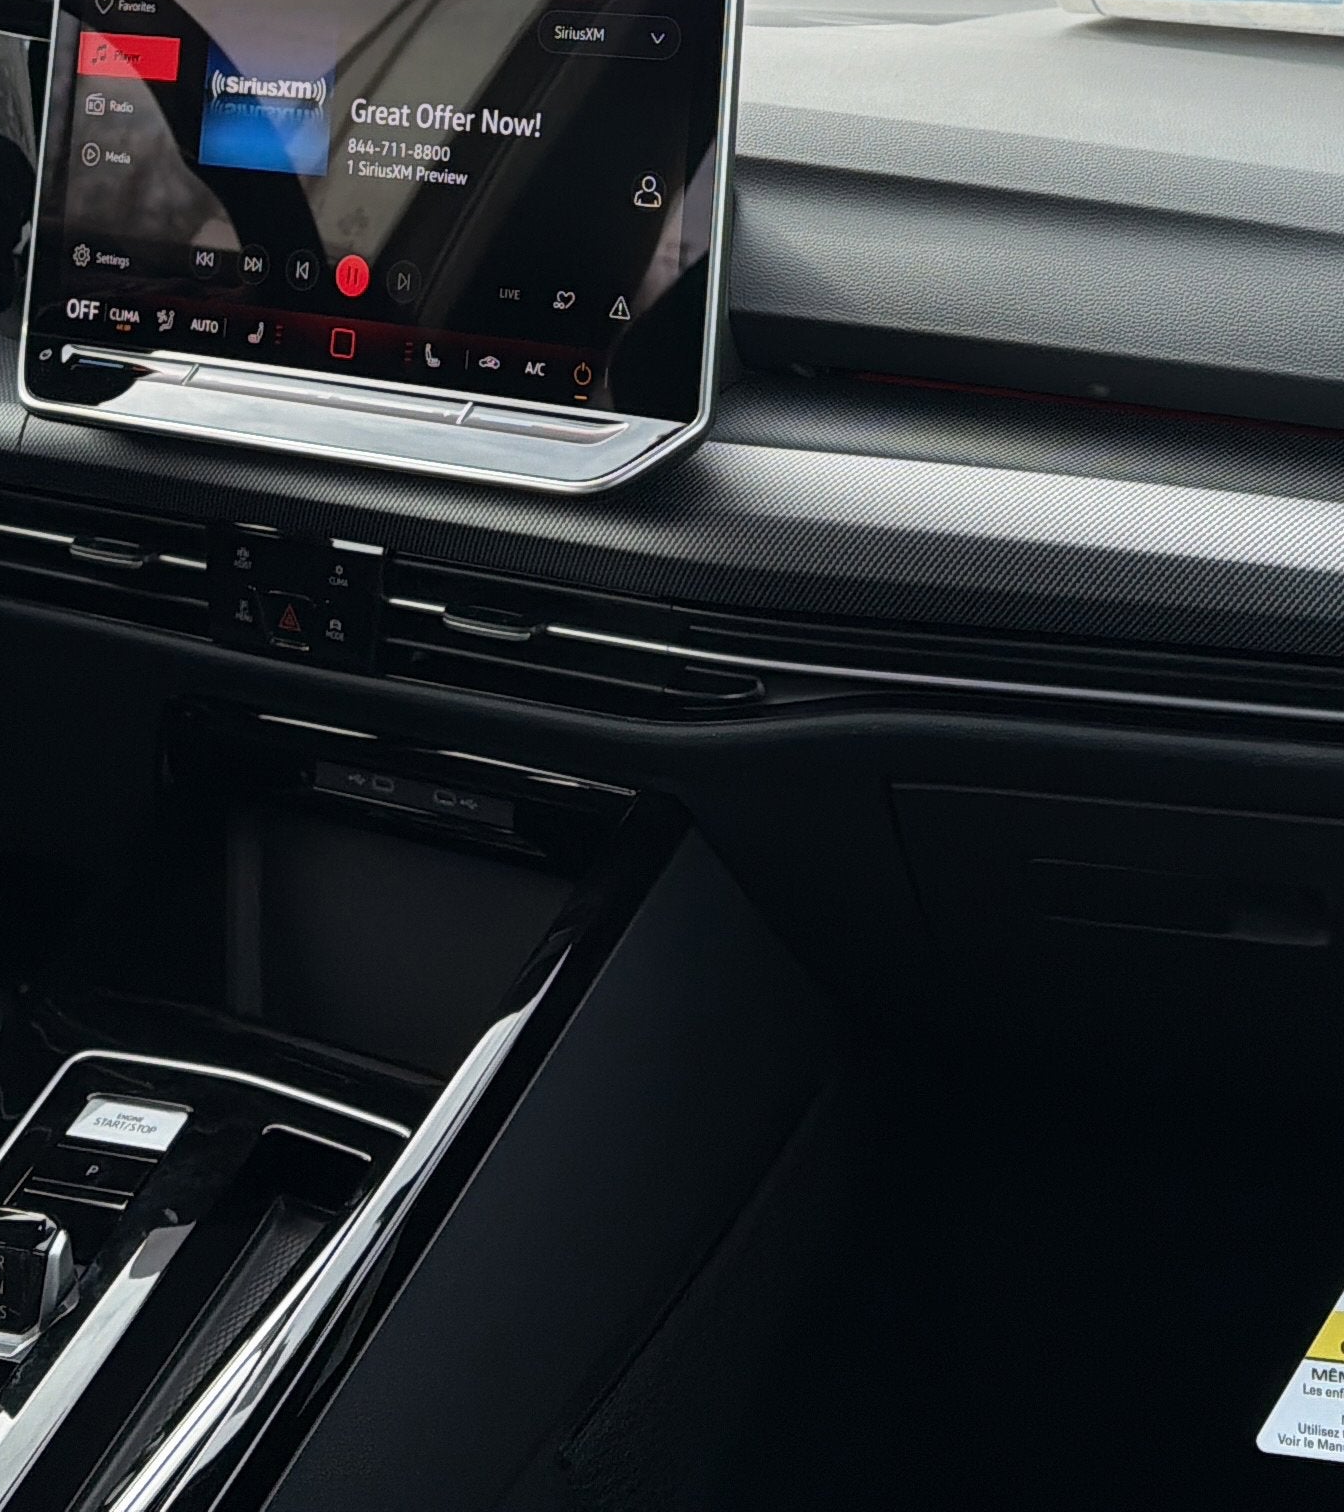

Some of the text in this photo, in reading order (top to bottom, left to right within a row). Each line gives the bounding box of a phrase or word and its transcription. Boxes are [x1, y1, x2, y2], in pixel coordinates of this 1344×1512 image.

[118, 0, 157, 14] Favorites
[554, 25, 606, 43] SiriusXM
[113, 49, 142, 65] Player
[109, 99, 135, 114] Radio
[350, 98, 543, 139] Great Offer Now!
[105, 150, 131, 165] Media
[347, 138, 451, 162] 844-711-8800
[358, 161, 414, 182] SiriusXM
[416, 166, 469, 186] Preview
[96, 253, 131, 270] Settings
[499, 287, 522, 301] LIVE
[66, 298, 101, 321] OFF
[109, 307, 141, 324] CLIMA
[190, 318, 220, 334] AUTO
[524, 361, 547, 377] A/C
[93, 1116, 159, 1134] START/STOP
[116, 1112, 145, 1123] ENGINE
[85, 1163, 100, 1177] P
